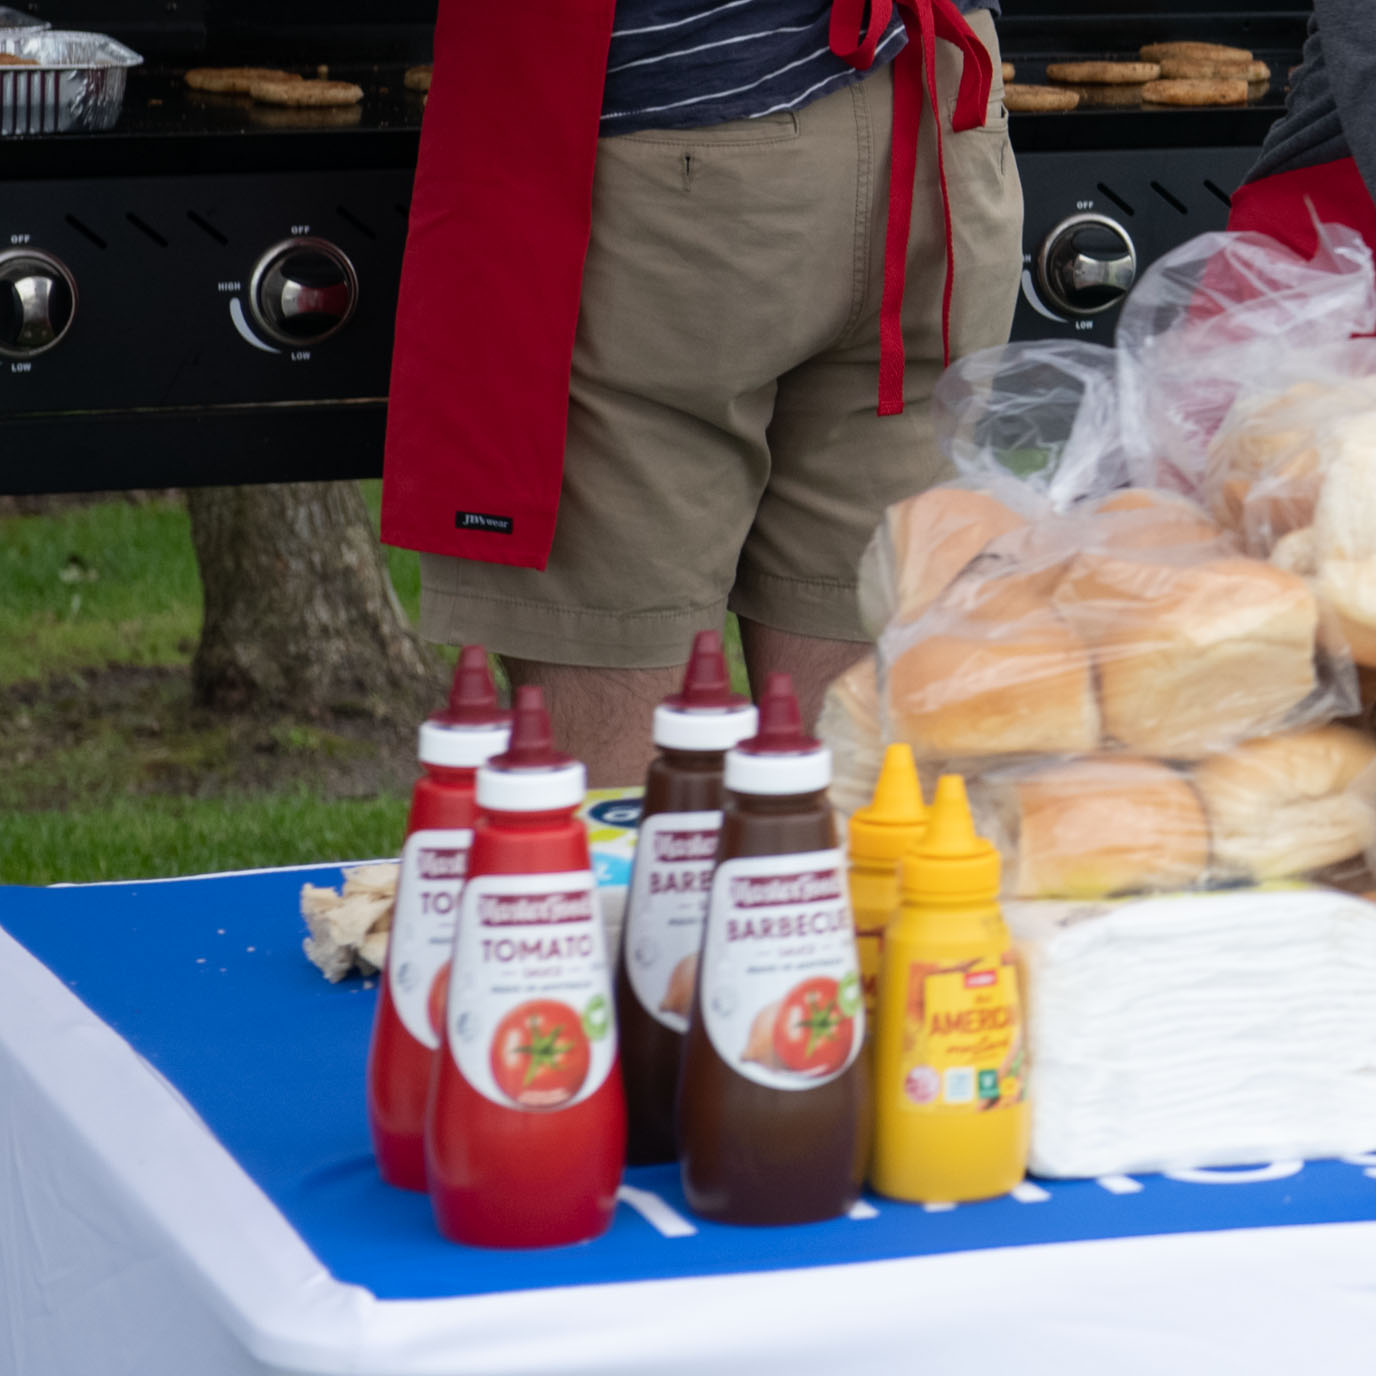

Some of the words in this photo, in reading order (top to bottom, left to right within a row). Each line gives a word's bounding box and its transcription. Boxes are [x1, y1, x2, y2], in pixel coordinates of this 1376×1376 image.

[1076, 200, 1094, 209] OFF
[291, 225, 310, 234] OFF
[11, 234, 30, 244] OFF
[218, 282, 241, 291] HIGH
[1075, 320, 1094, 330] LOW
[291, 351, 311, 361] LOW
[11, 362, 31, 372] LOW
[481, 935, 593, 963] TOMATO
